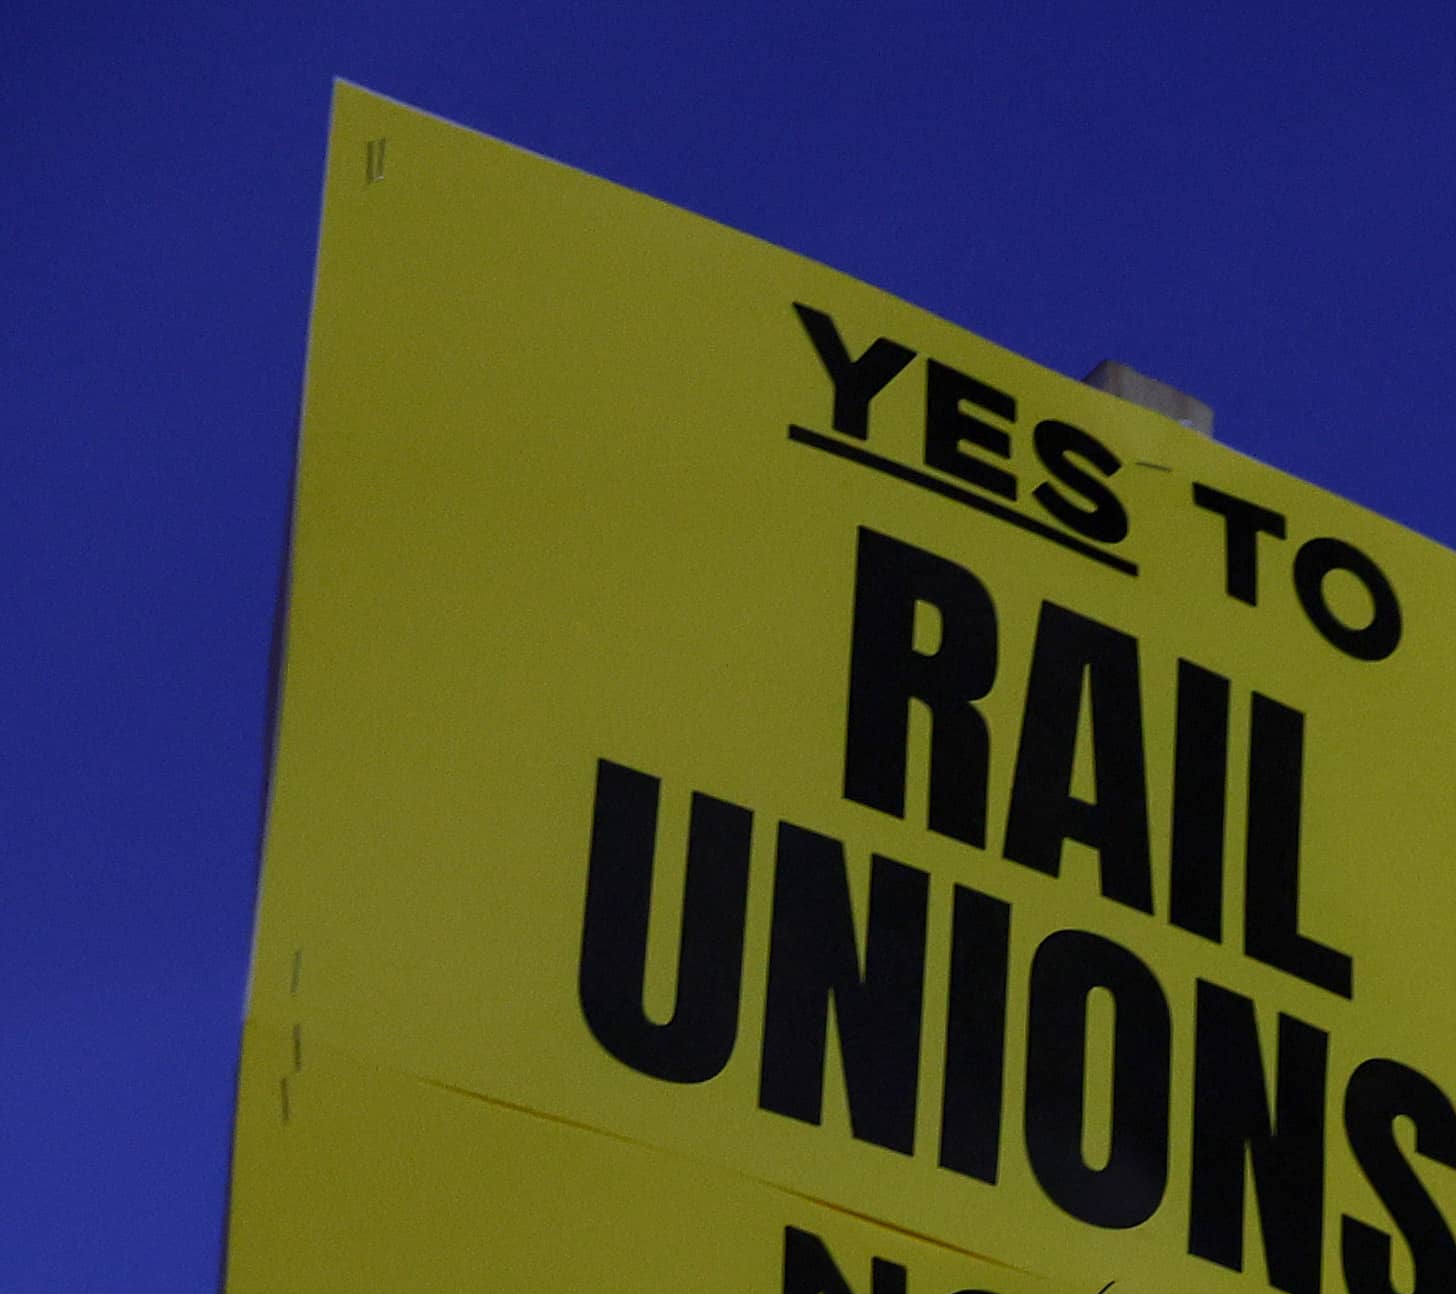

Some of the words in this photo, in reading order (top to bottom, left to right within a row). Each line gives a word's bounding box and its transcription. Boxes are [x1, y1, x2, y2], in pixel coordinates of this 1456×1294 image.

[792, 302, 1129, 543] YES
[1192, 482, 1402, 661] TO
[841, 524, 1353, 1000] RAIL
